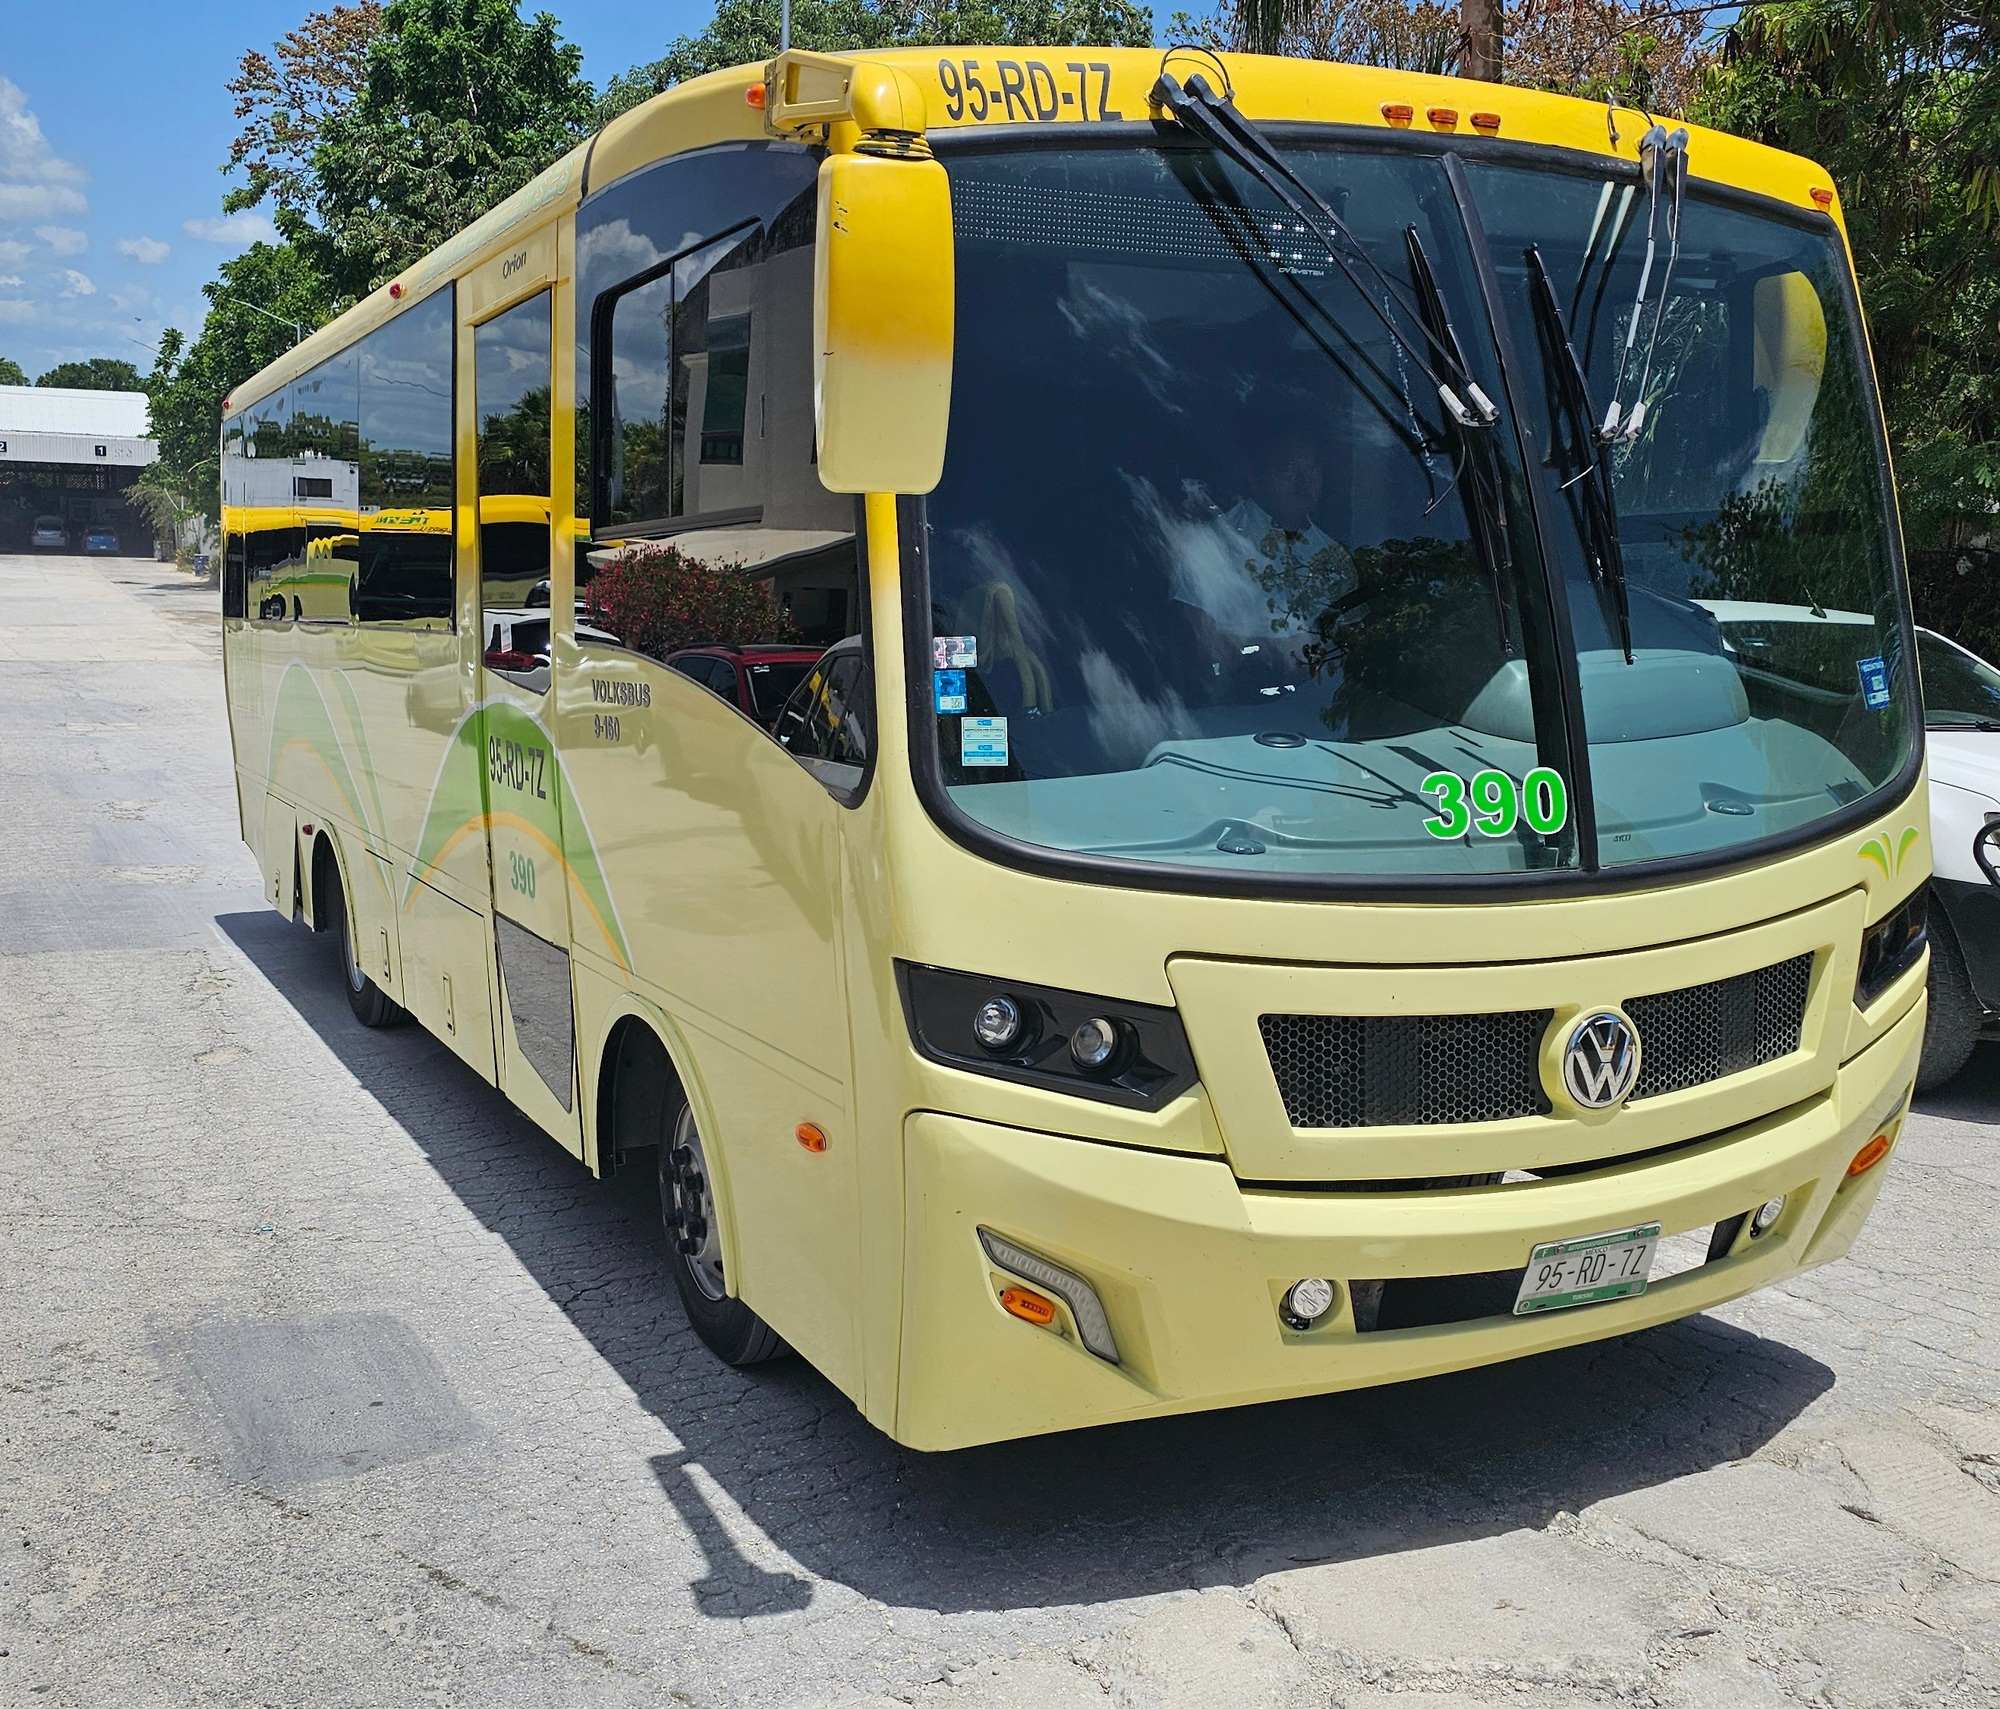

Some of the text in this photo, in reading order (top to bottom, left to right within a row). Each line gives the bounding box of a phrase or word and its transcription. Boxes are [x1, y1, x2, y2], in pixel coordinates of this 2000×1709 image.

[938, 58, 1123, 122] 95-RD-7Z
[502, 250, 527, 279] Orion
[592, 678, 651, 708] VOLKSBUS
[594, 714, 620, 742] 9-160
[489, 735, 546, 800] 95-RD-7Z
[1420, 767, 1568, 840] 390
[510, 850, 536, 899] 390
[1565, 1014, 1635, 1107] VW
[1535, 1244, 1647, 1292] 95-RD-7Z
